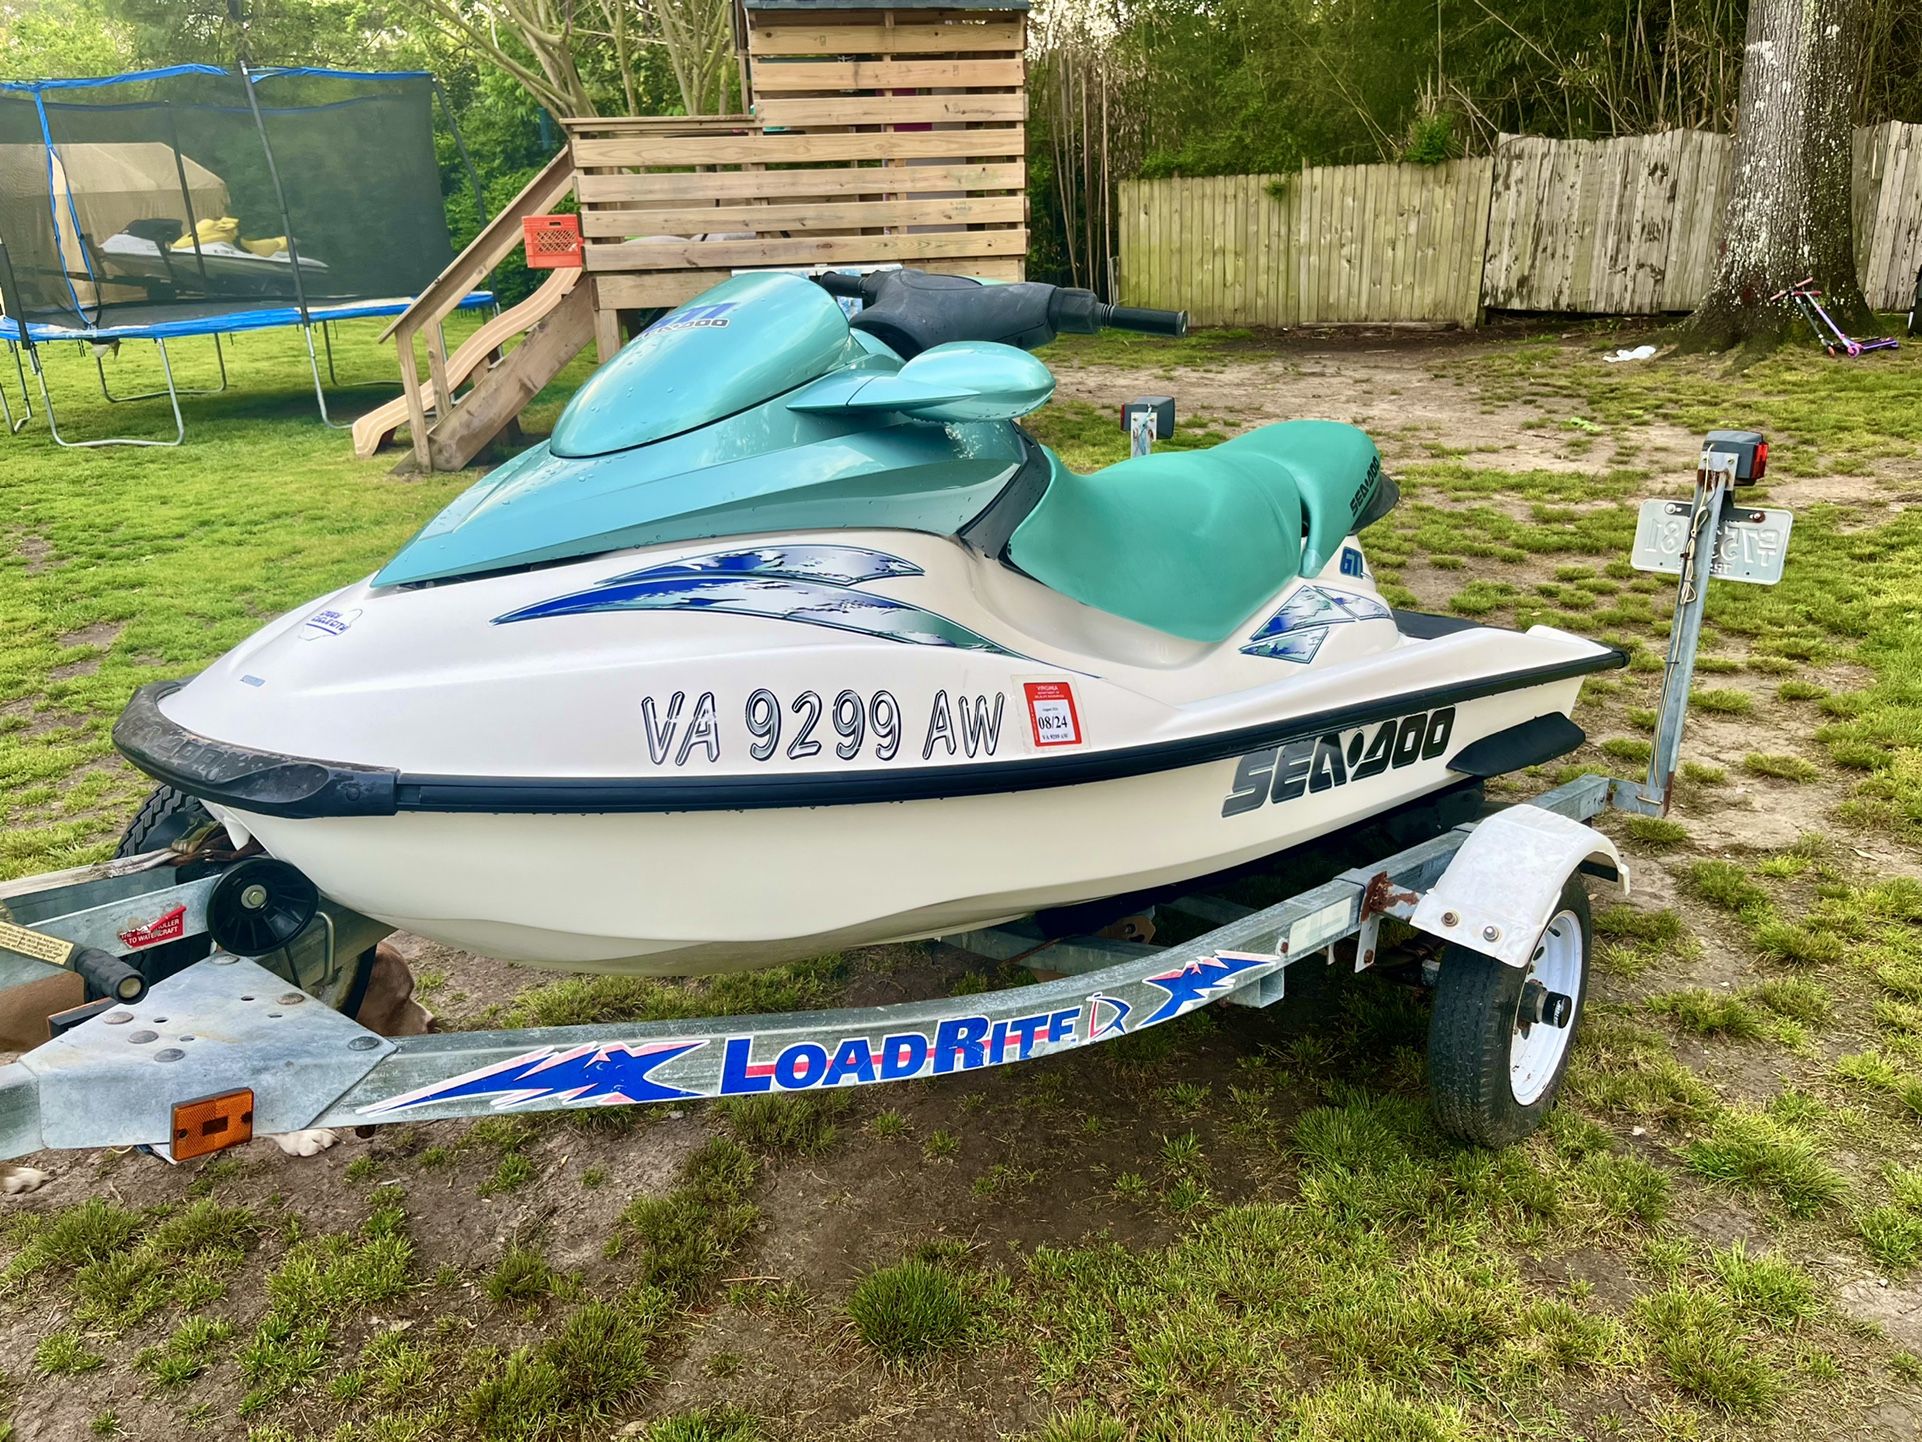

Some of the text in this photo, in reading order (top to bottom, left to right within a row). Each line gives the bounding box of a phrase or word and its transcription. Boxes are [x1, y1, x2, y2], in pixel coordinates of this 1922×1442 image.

[641, 690, 721, 766] VA
[744, 687, 902, 761] 9299
[922, 689, 1004, 760] AW
[1038, 715, 1068, 730] 08/24
[128, 936, 137, 944] TO
